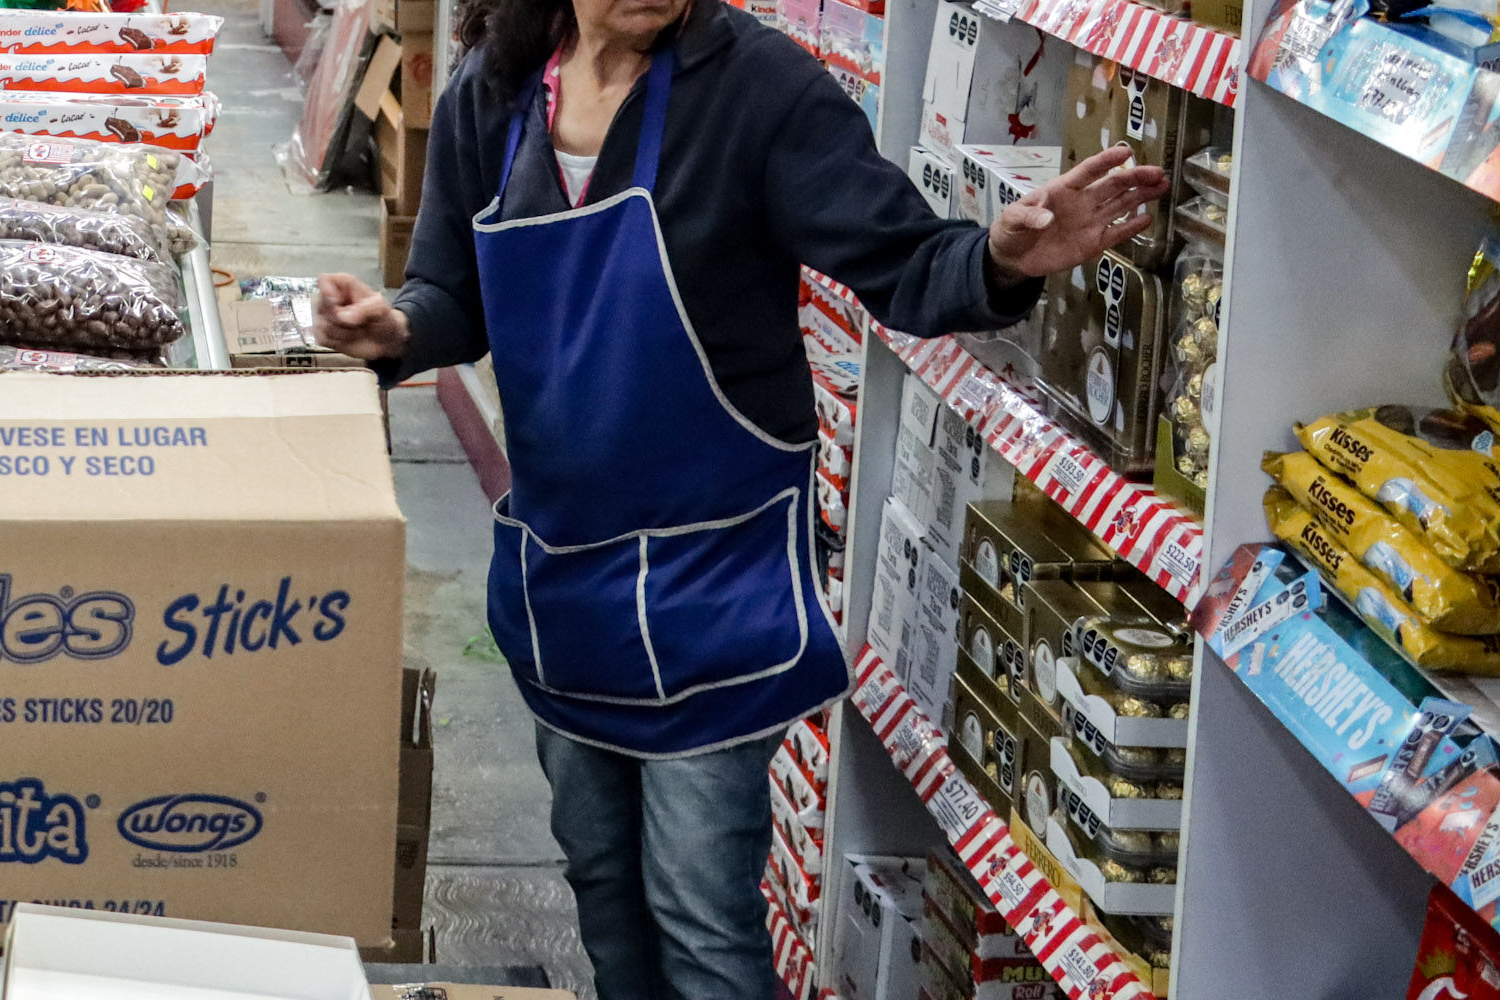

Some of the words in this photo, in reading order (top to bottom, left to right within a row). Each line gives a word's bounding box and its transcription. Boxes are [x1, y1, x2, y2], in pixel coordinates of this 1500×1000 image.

[75, 426, 108, 447] EN
[117, 426, 208, 447] LUGAR
[59, 455, 77, 476] Y
[86, 455, 156, 476] SECO
[1058, 455, 1086, 484] $193.50
[1165, 541, 1196, 573] $222.50
[156, 576, 350, 666] Stick's
[1222, 600, 1272, 644] HERSHEY'S
[1273, 632, 1394, 751] HERSHEY'S
[24, 697, 104, 723] STICKS
[111, 697, 174, 724] 20/20
[943, 778, 979, 821] $77.40
[206, 853, 238, 868] 1918
[1025, 833, 1062, 889] FERRERO
[1003, 869, 1024, 897] $94.50
